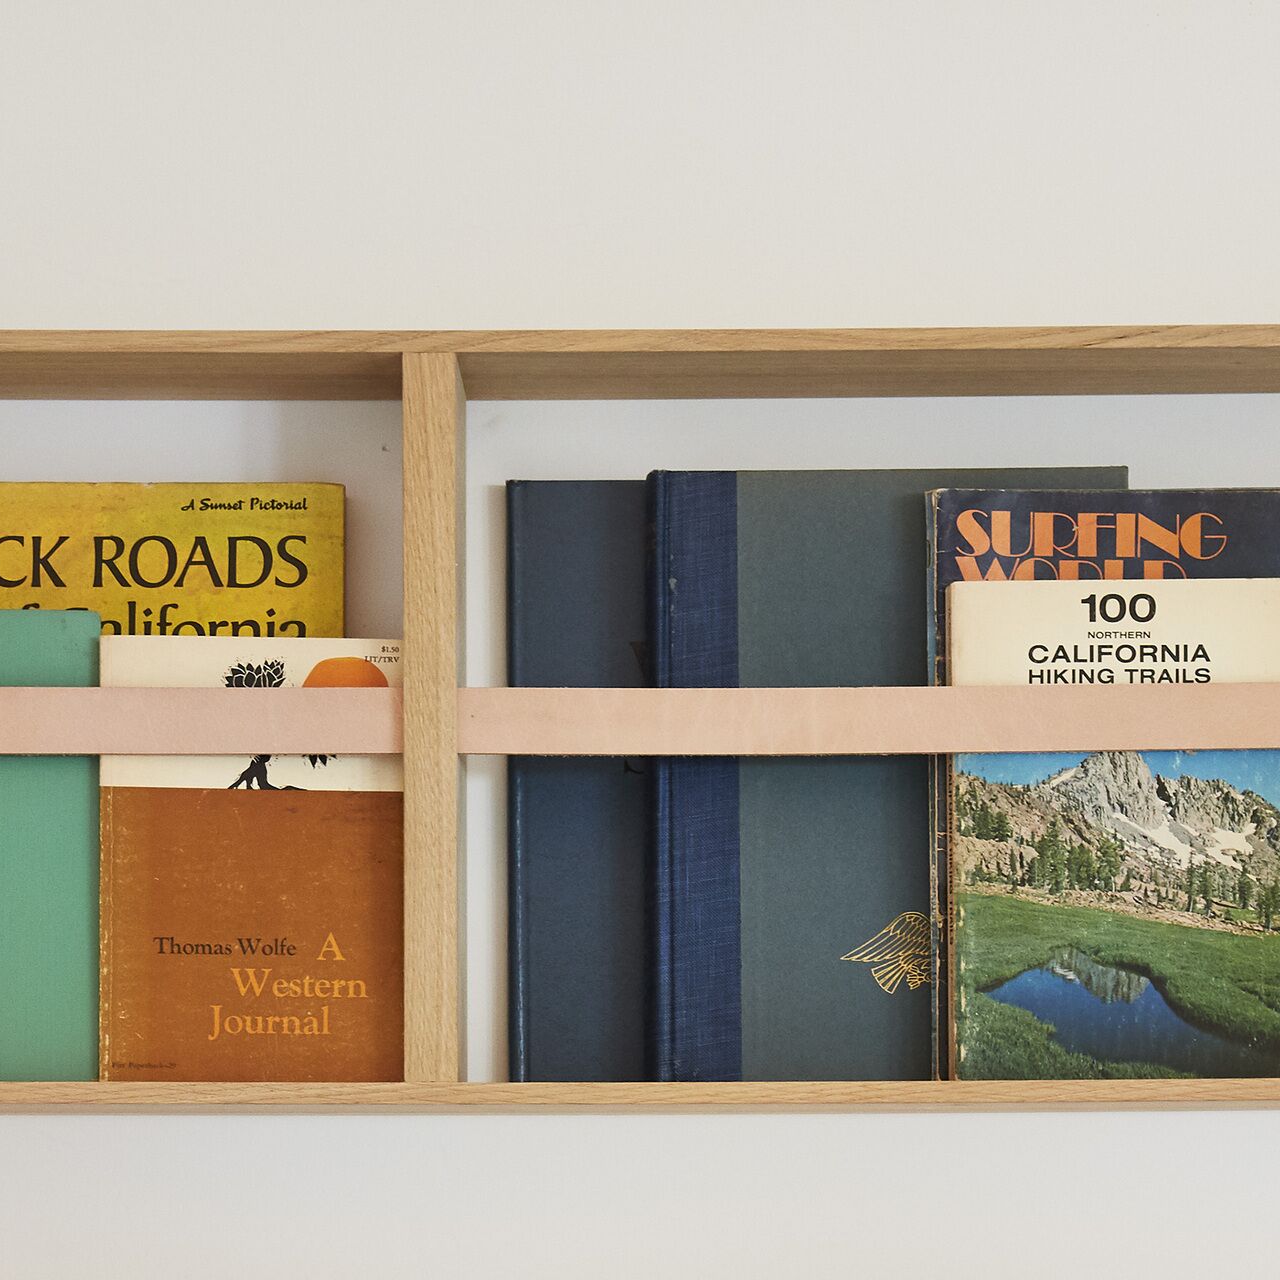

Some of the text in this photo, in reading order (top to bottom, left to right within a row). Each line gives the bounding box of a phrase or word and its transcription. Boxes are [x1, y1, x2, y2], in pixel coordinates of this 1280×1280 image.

[181, 498, 308, 511] A Sunset Pictorial
[955, 509, 1227, 560] SURFING
[92, 536, 309, 588] ROADS
[1081, 593, 1156, 623] 100
[1087, 631, 1151, 639] NORTHERN
[1028, 644, 1211, 663] CALIFORNIA
[1028, 669, 1211, 684] HIKING TRAILS
[153, 936, 297, 957] Thomas Wolfe
[316, 933, 345, 961] A
[231, 969, 368, 998] Western
[208, 1005, 331, 1041] Journal
